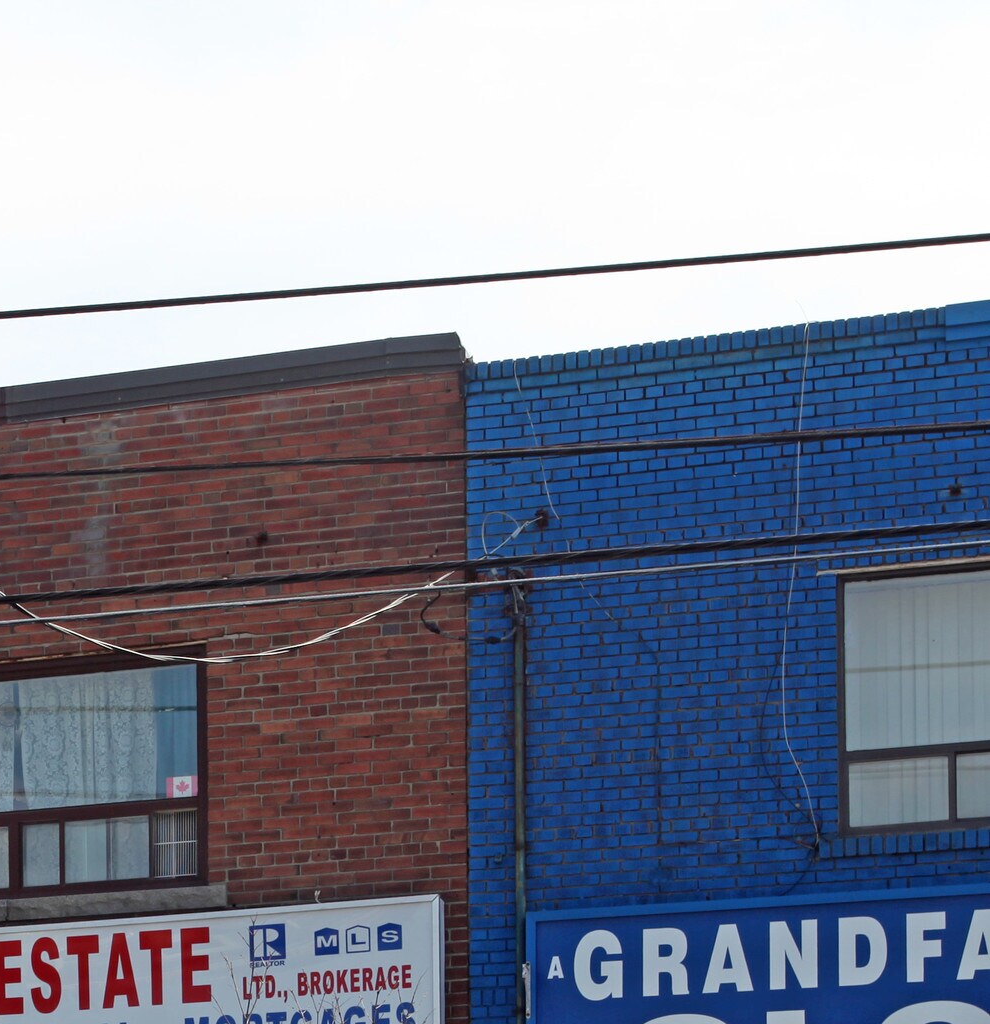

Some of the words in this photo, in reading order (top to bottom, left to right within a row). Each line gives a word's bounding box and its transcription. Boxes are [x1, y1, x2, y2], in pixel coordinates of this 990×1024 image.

[242, 974, 288, 1003] LTD.,
[297, 964, 412, 997] BROKERAGE
[547, 955, 564, 980] A
[573, 909, 990, 1002] GRANDFA
